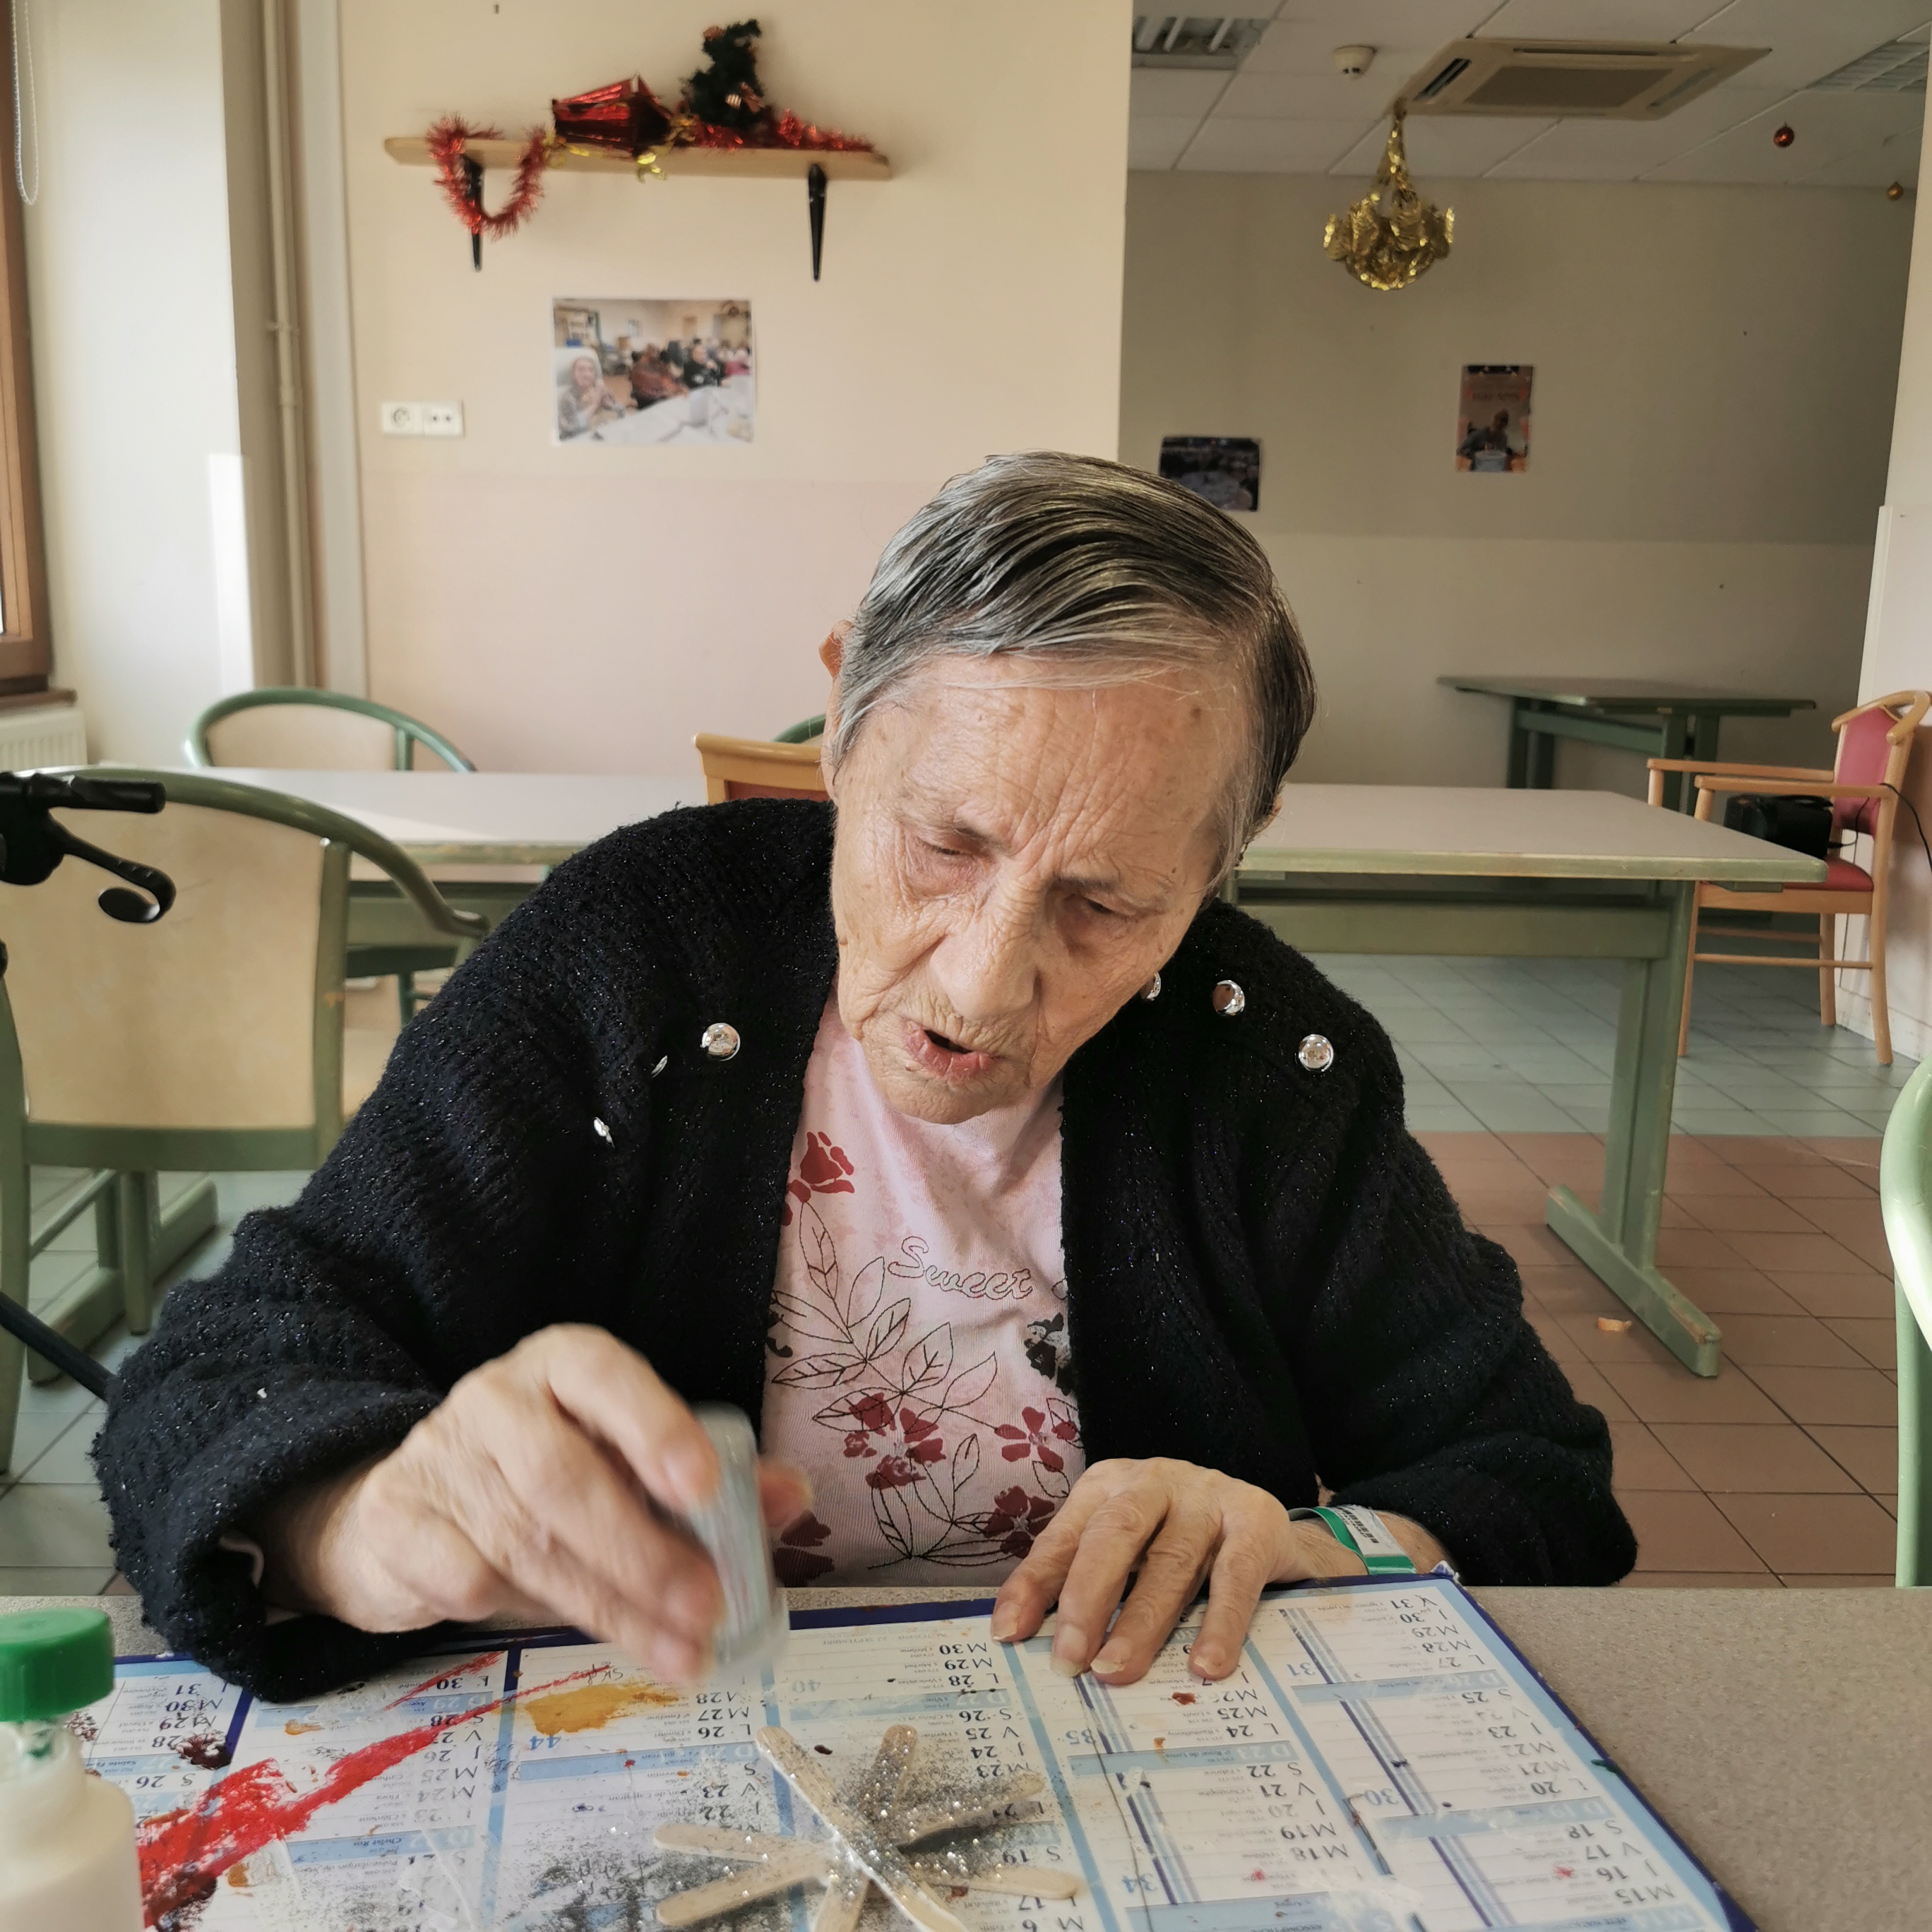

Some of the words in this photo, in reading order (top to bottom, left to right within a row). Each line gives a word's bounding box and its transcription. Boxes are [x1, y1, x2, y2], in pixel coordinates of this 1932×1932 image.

[888, 1235, 1033, 1300] Sweet
[1388, 1598, 1414, 1610] 31
[1398, 1612, 1424, 1624] 30
[1410, 1626, 1436, 1638] 29
[1435, 1624, 1458, 1636] M
[938, 1644, 964, 1655] 30
[965, 1642, 986, 1654] M
[1421, 1641, 1448, 1654] 28
[1446, 1639, 1471, 1651] M
[943, 1659, 970, 1671] 29
[971, 1657, 991, 1669] M
[1438, 1657, 1461, 1669] 27
[1467, 1654, 1484, 1665] L
[1286, 1662, 1315, 1676] 31
[436, 1677, 463, 1690] 30
[946, 1674, 974, 1687] 28
[985, 1672, 999, 1685] L
[174, 1683, 202, 1696] 31
[790, 1679, 821, 1693] 40
[695, 1692, 722, 1704] 28
[986, 1691, 1005, 1703] D
[1234, 1688, 1258, 1702] M
[1460, 1691, 1489, 1704] 25
[1496, 1688, 1511, 1700] S
[164, 1699, 195, 1713] 30
[198, 1698, 222, 1710] M
[432, 1696, 460, 1710] 29
[466, 1695, 486, 1708] D
[696, 1709, 722, 1722] 27
[727, 1706, 749, 1720] M
[958, 1710, 986, 1724] 26
[998, 1707, 1011, 1721] S
[1215, 1707, 1244, 1720] 25
[1244, 1705, 1268, 1717] M
[158, 1716, 189, 1732] 29
[429, 1714, 455, 1727] 28
[463, 1729, 482, 1742] V
[696, 1727, 724, 1739] 26
[738, 1724, 751, 1736] L
[964, 1727, 992, 1741] 25
[1001, 1727, 1019, 1739] V
[1224, 1724, 1253, 1739] 24
[1263, 1722, 1279, 1735] L
[1486, 1725, 1516, 1739] 23
[150, 1735, 182, 1751] 28
[528, 1736, 561, 1751] 44
[1064, 1729, 1095, 1746] 35
[473, 1744, 482, 1760] J
[970, 1746, 998, 1760] 24
[1235, 1746, 1263, 1761] 23
[1269, 1743, 1290, 1757] D
[1528, 1741, 1556, 1754] M
[422, 1748, 452, 1764] 26
[454, 1766, 477, 1779] M
[743, 1763, 756, 1776] S
[974, 1764, 1003, 1779] 23
[1245, 1765, 1275, 1778] 22
[1287, 1762, 1301, 1775] S
[1516, 1762, 1546, 1776] 21
[1542, 1759, 1570, 1773] M
[135, 1775, 166, 1790] 26
[180, 1772, 196, 1787] S
[419, 1768, 450, 1784] 25
[701, 1784, 729, 1799] 23
[739, 1782, 756, 1797] V
[1258, 1783, 1287, 1798] 21
[1296, 1782, 1315, 1794] V
[1529, 1780, 1561, 1796] 20
[1567, 1778, 1587, 1791] L
[417, 1787, 446, 1803] 24
[452, 1785, 475, 1800] M
[1196, 1788, 1244, 1796] Christophe
[1363, 1787, 1398, 1806] 30
[357, 1813, 399, 1822] Clément
[412, 1808, 443, 1823] 23
[699, 1804, 729, 1821] 22
[1268, 1803, 1298, 1819] 20
[1279, 1824, 1308, 1840] 19
[1310, 1822, 1336, 1837] M
[1567, 1823, 1594, 1839] 18
[1603, 1820, 1622, 1835] S
[371, 1837, 402, 1846] Christ
[1001, 1849, 1030, 1864] 19
[1044, 1845, 1061, 1862] S
[1289, 1846, 1319, 1861] 18
[1321, 1843, 1349, 1859] M
[1585, 1844, 1610, 1861] 17
[1621, 1842, 1642, 1857] V
[1595, 1866, 1628, 1883] 16
[1121, 1873, 1157, 1894] 34
[1614, 1888, 1645, 1905] 15
[1644, 1883, 1676, 1901] M
[1017, 1895, 1045, 1912] 17
[1056, 1915, 1083, 1932] M
